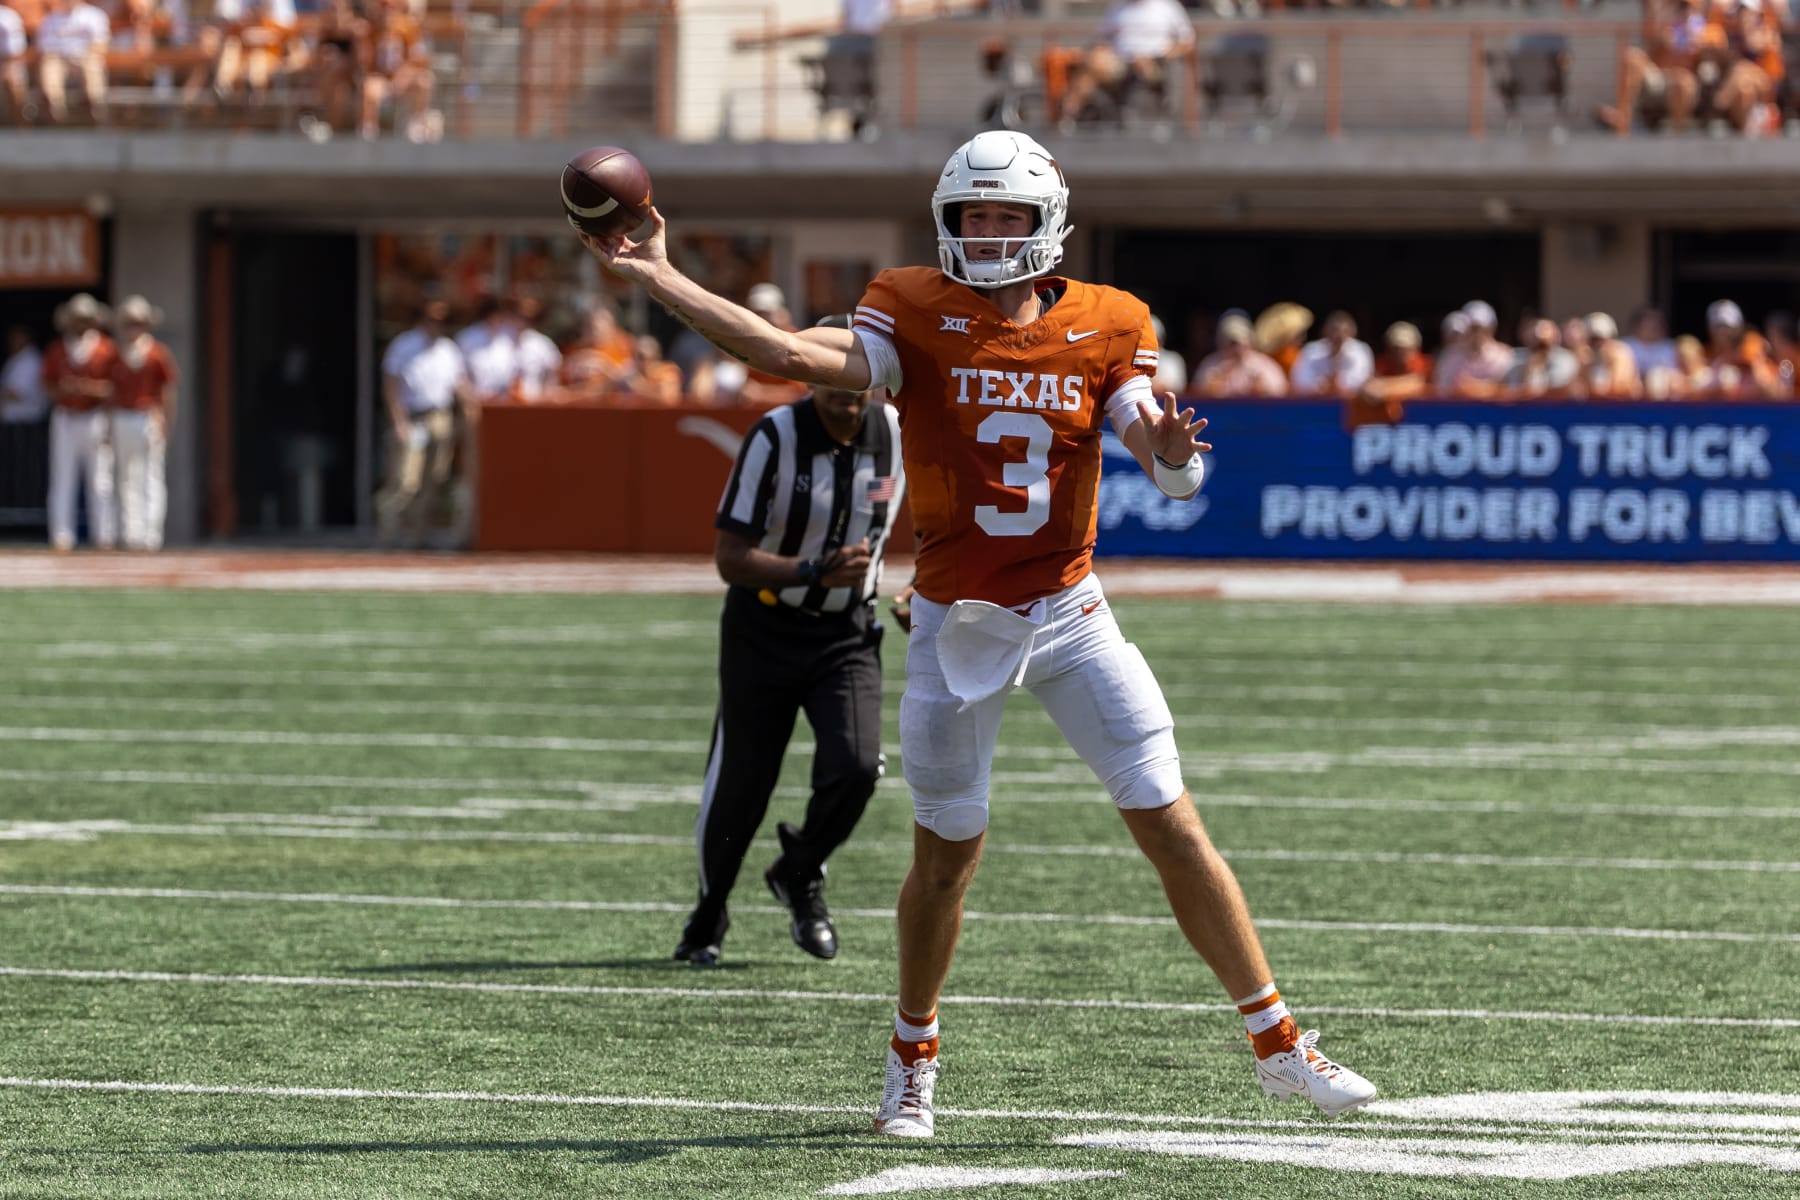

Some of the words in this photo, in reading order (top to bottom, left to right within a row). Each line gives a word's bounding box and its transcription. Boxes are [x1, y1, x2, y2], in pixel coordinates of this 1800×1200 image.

[972, 180, 999, 188] HORNS
[951, 367, 1084, 411] TEXAS
[974, 411, 1054, 537] 3
[1354, 424, 1561, 477] PROUD
[1567, 425, 1770, 478] TRUCK
[1261, 485, 1559, 541] PROVIDER
[1569, 488, 1689, 542] FOR
